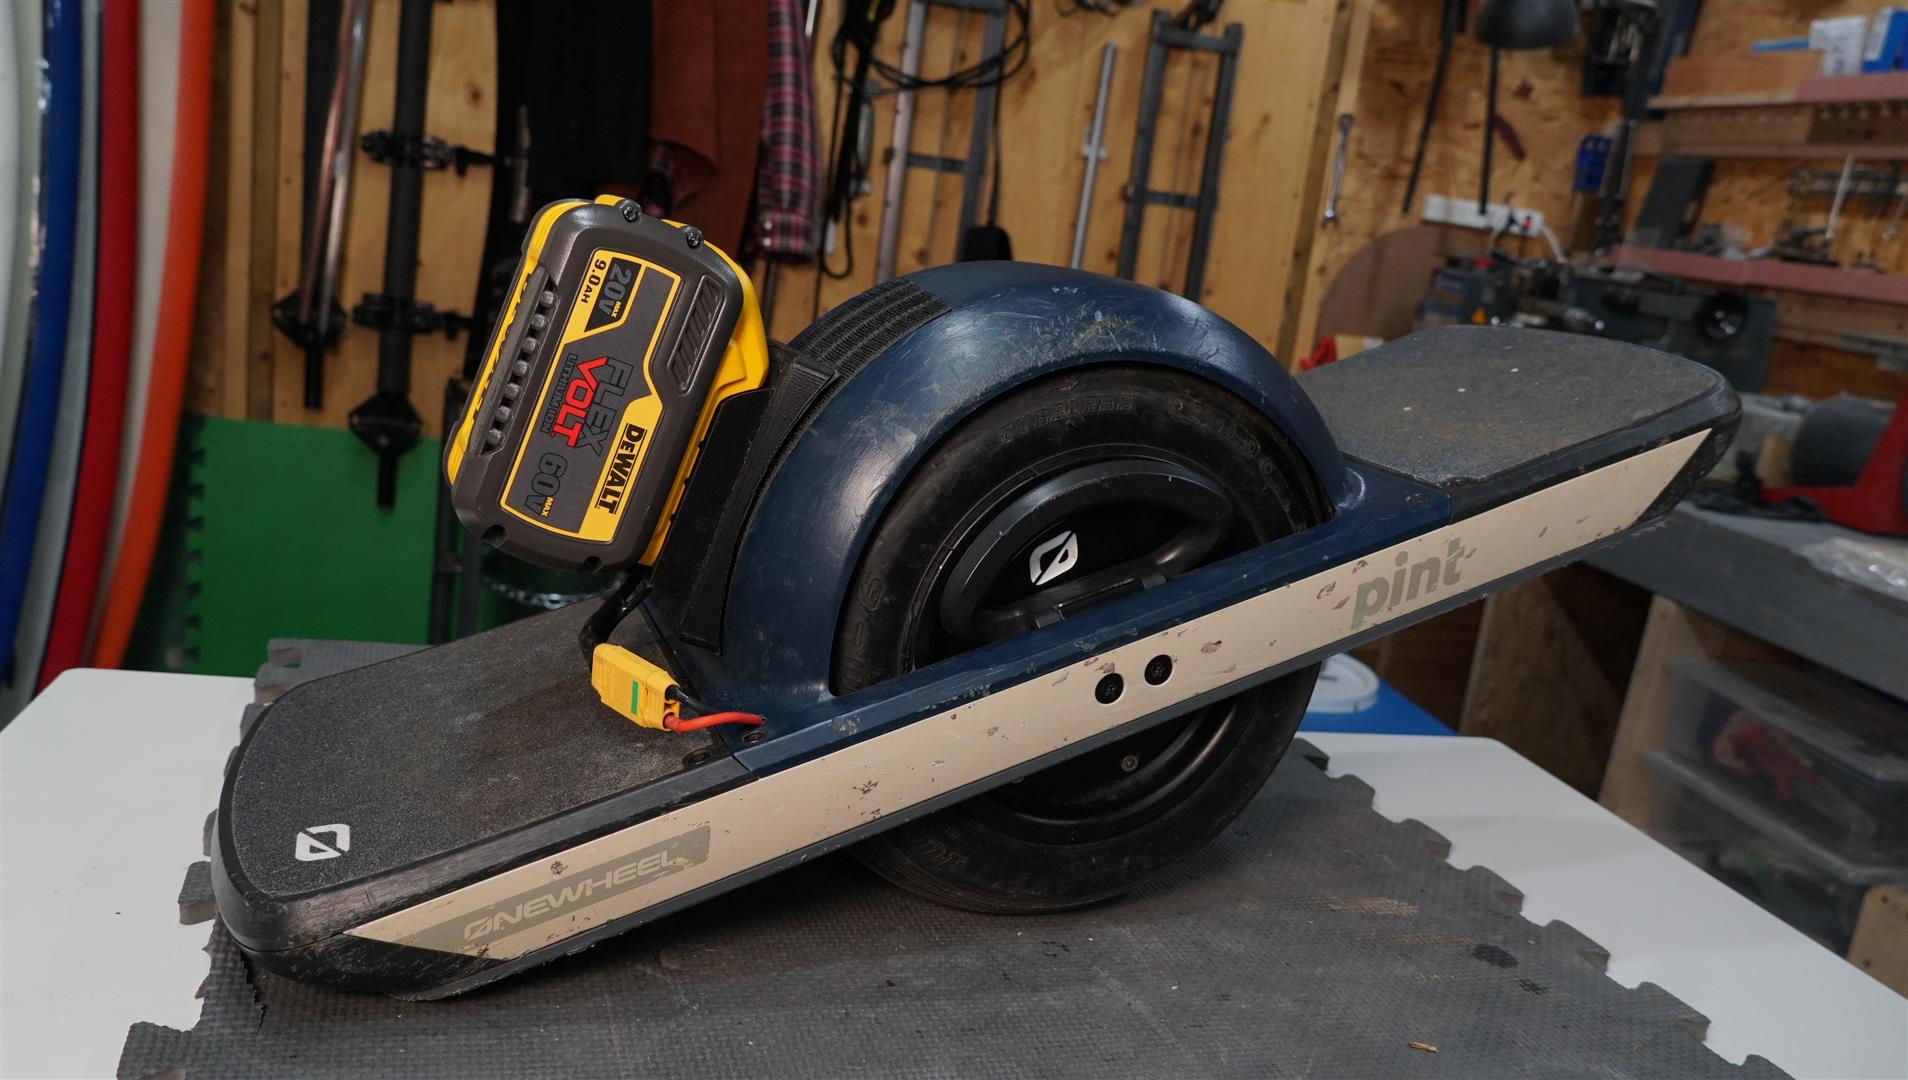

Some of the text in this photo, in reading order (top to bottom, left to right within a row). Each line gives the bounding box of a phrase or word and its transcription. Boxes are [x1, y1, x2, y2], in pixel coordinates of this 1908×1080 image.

[599, 263, 632, 318] 20V MAX
[540, 352, 579, 435] LITHIUM ION
[552, 355, 609, 447] VOLT
[575, 356, 634, 457] FLEX
[525, 452, 568, 518] 60V MAX
[1351, 537, 1465, 630] pint
